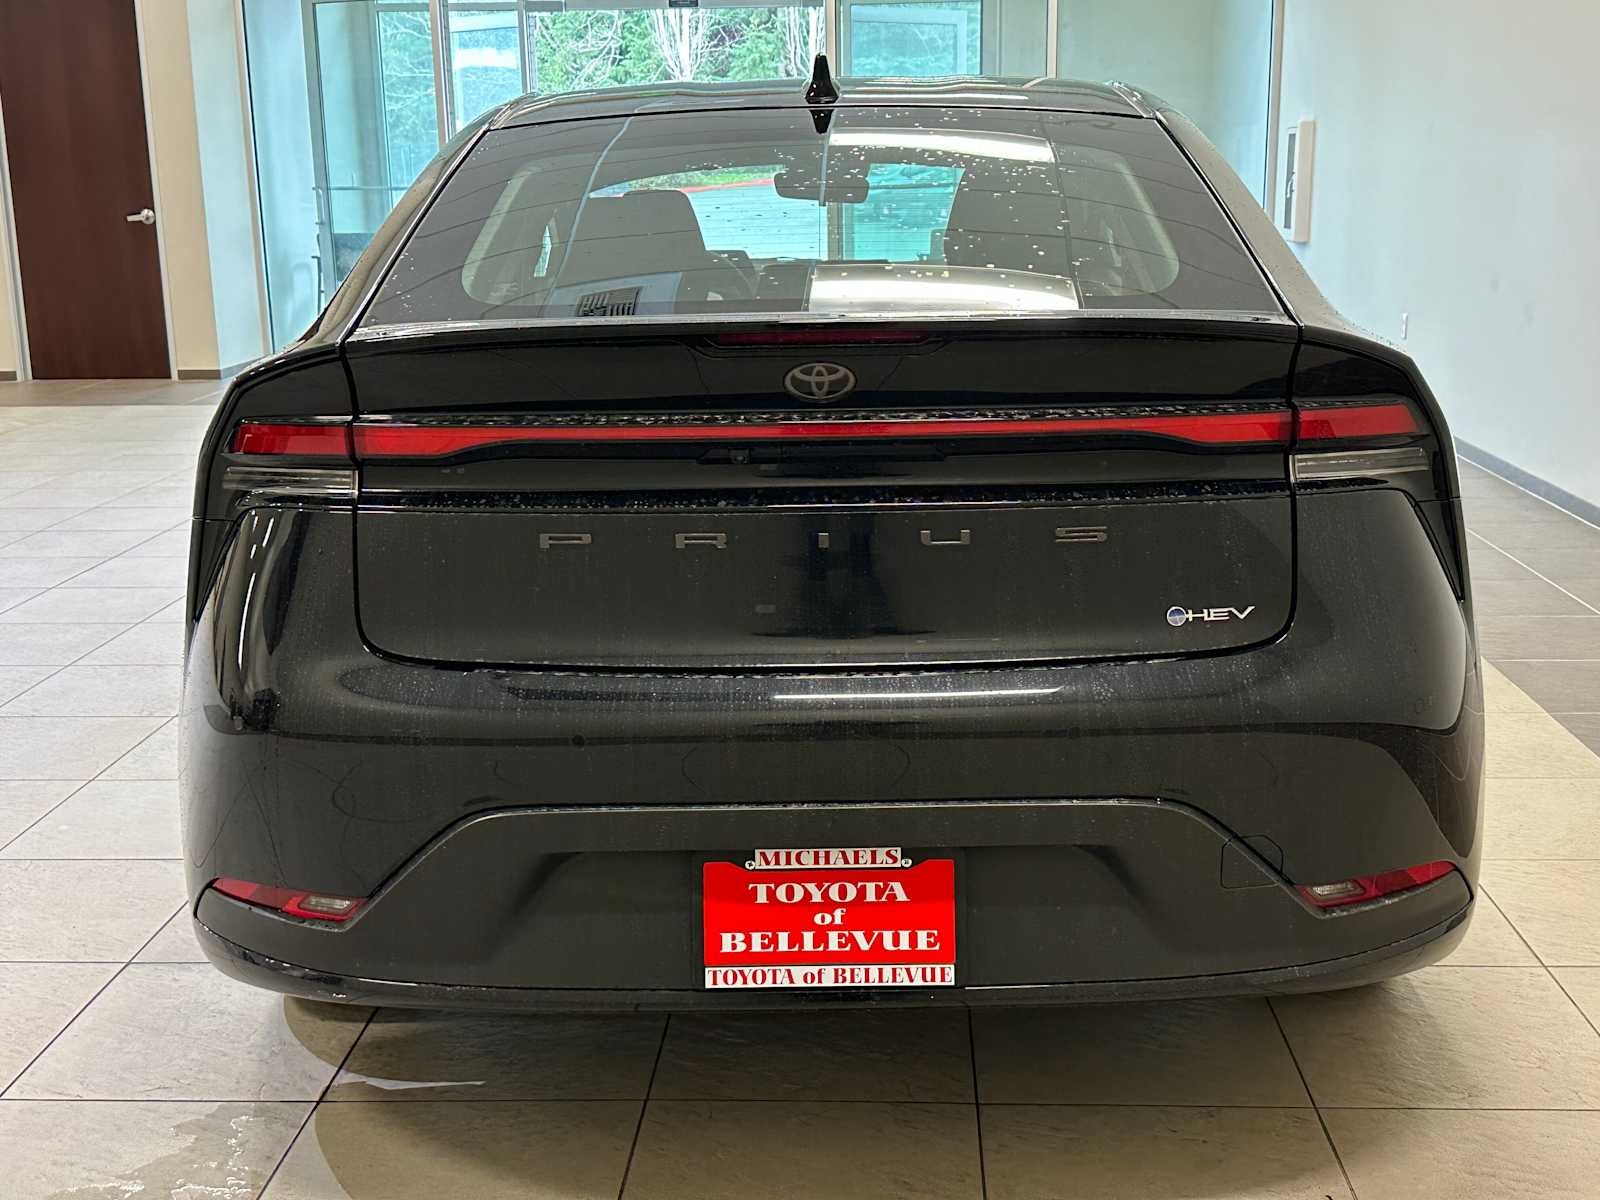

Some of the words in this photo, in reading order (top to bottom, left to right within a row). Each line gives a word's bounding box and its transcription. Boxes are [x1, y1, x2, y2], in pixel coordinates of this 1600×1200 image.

[539, 525, 1108, 550] PRIUS
[1187, 606, 1255, 621] HEV
[759, 849, 898, 866] MICHAELS
[748, 882, 910, 903] TOYOTA
[813, 908, 846, 925] of
[720, 930, 940, 952] BELLEVUE
[708, 969, 795, 986] TOYOTA
[802, 968, 826, 985] of
[833, 967, 952, 985] BELLEVUE
